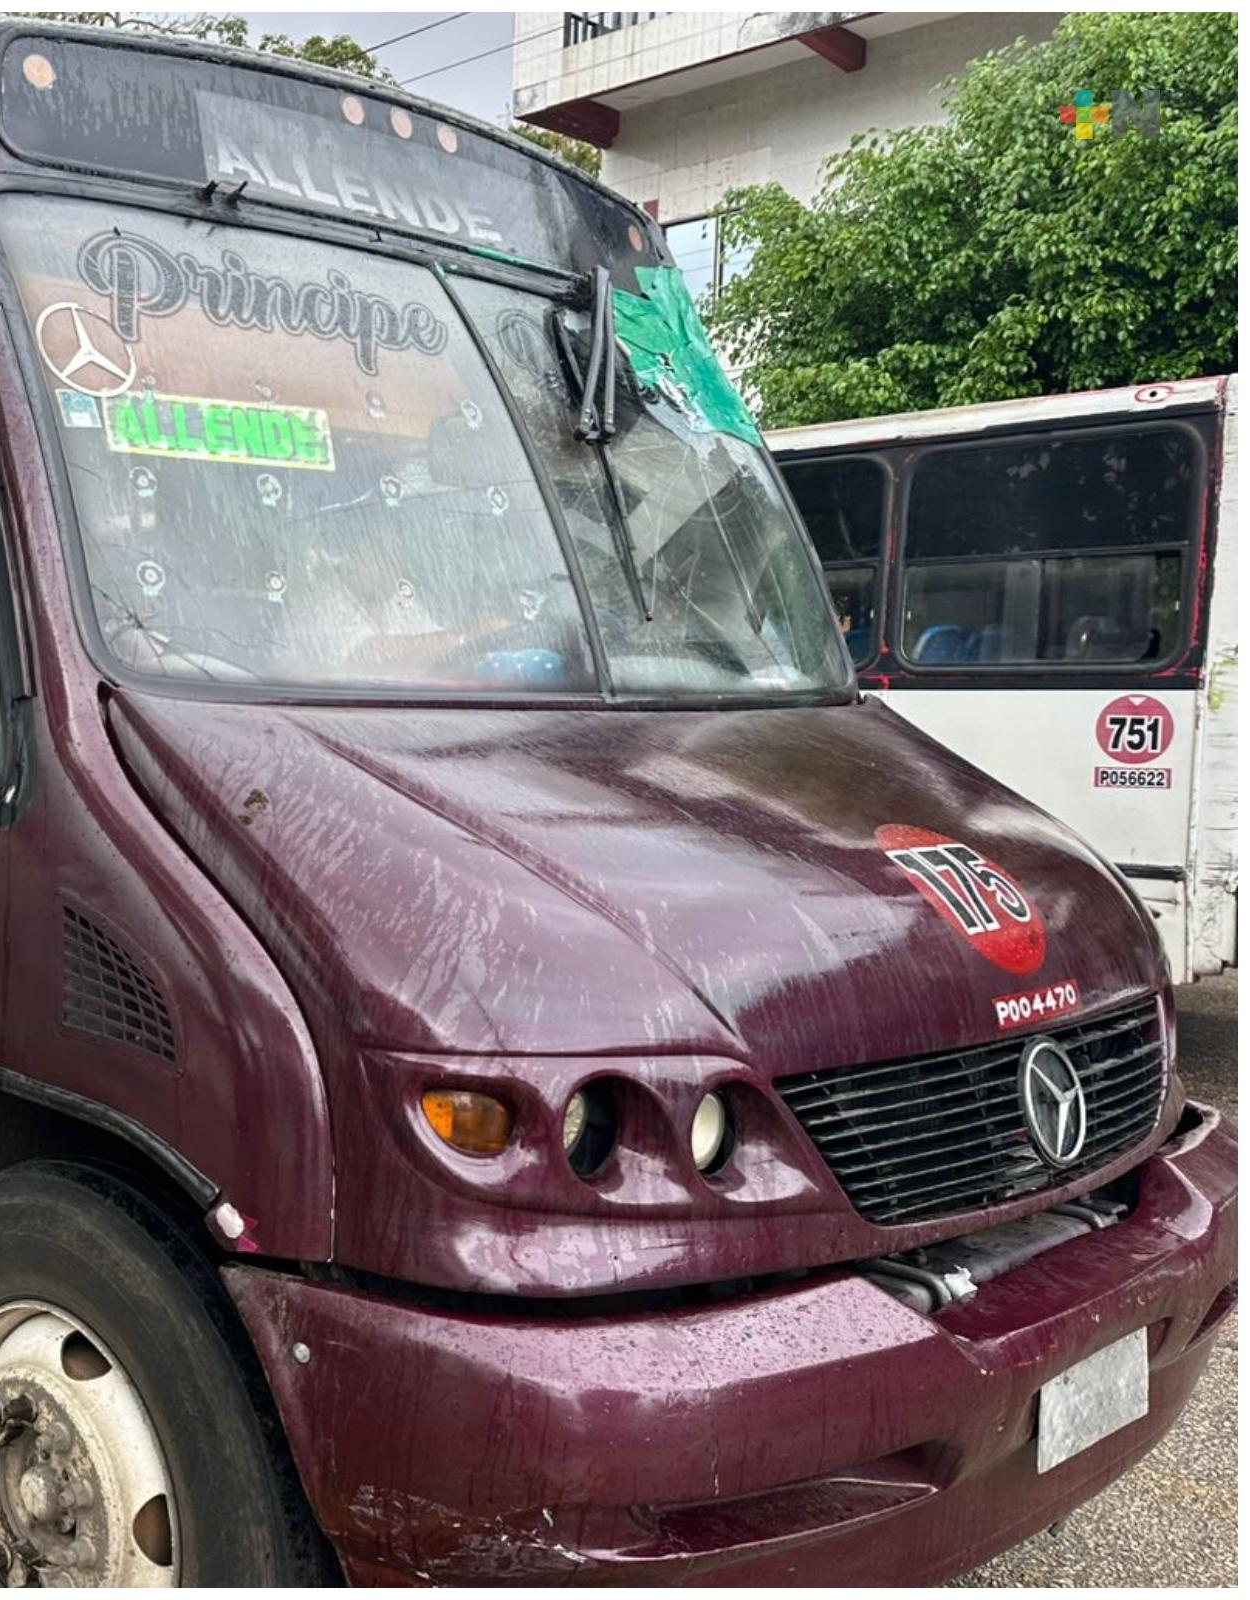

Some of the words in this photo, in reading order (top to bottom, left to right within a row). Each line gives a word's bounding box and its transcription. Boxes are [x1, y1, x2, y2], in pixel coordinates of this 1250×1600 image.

[216, 136, 503, 242] ALLENDE
[77, 230, 448, 376] Principe
[111, 397, 331, 464] ALLENDE
[1106, 715, 1163, 753] 751
[1100, 770, 1165, 786] P056622
[885, 843, 1031, 935] 175
[995, 983, 1077, 1026] P004470
